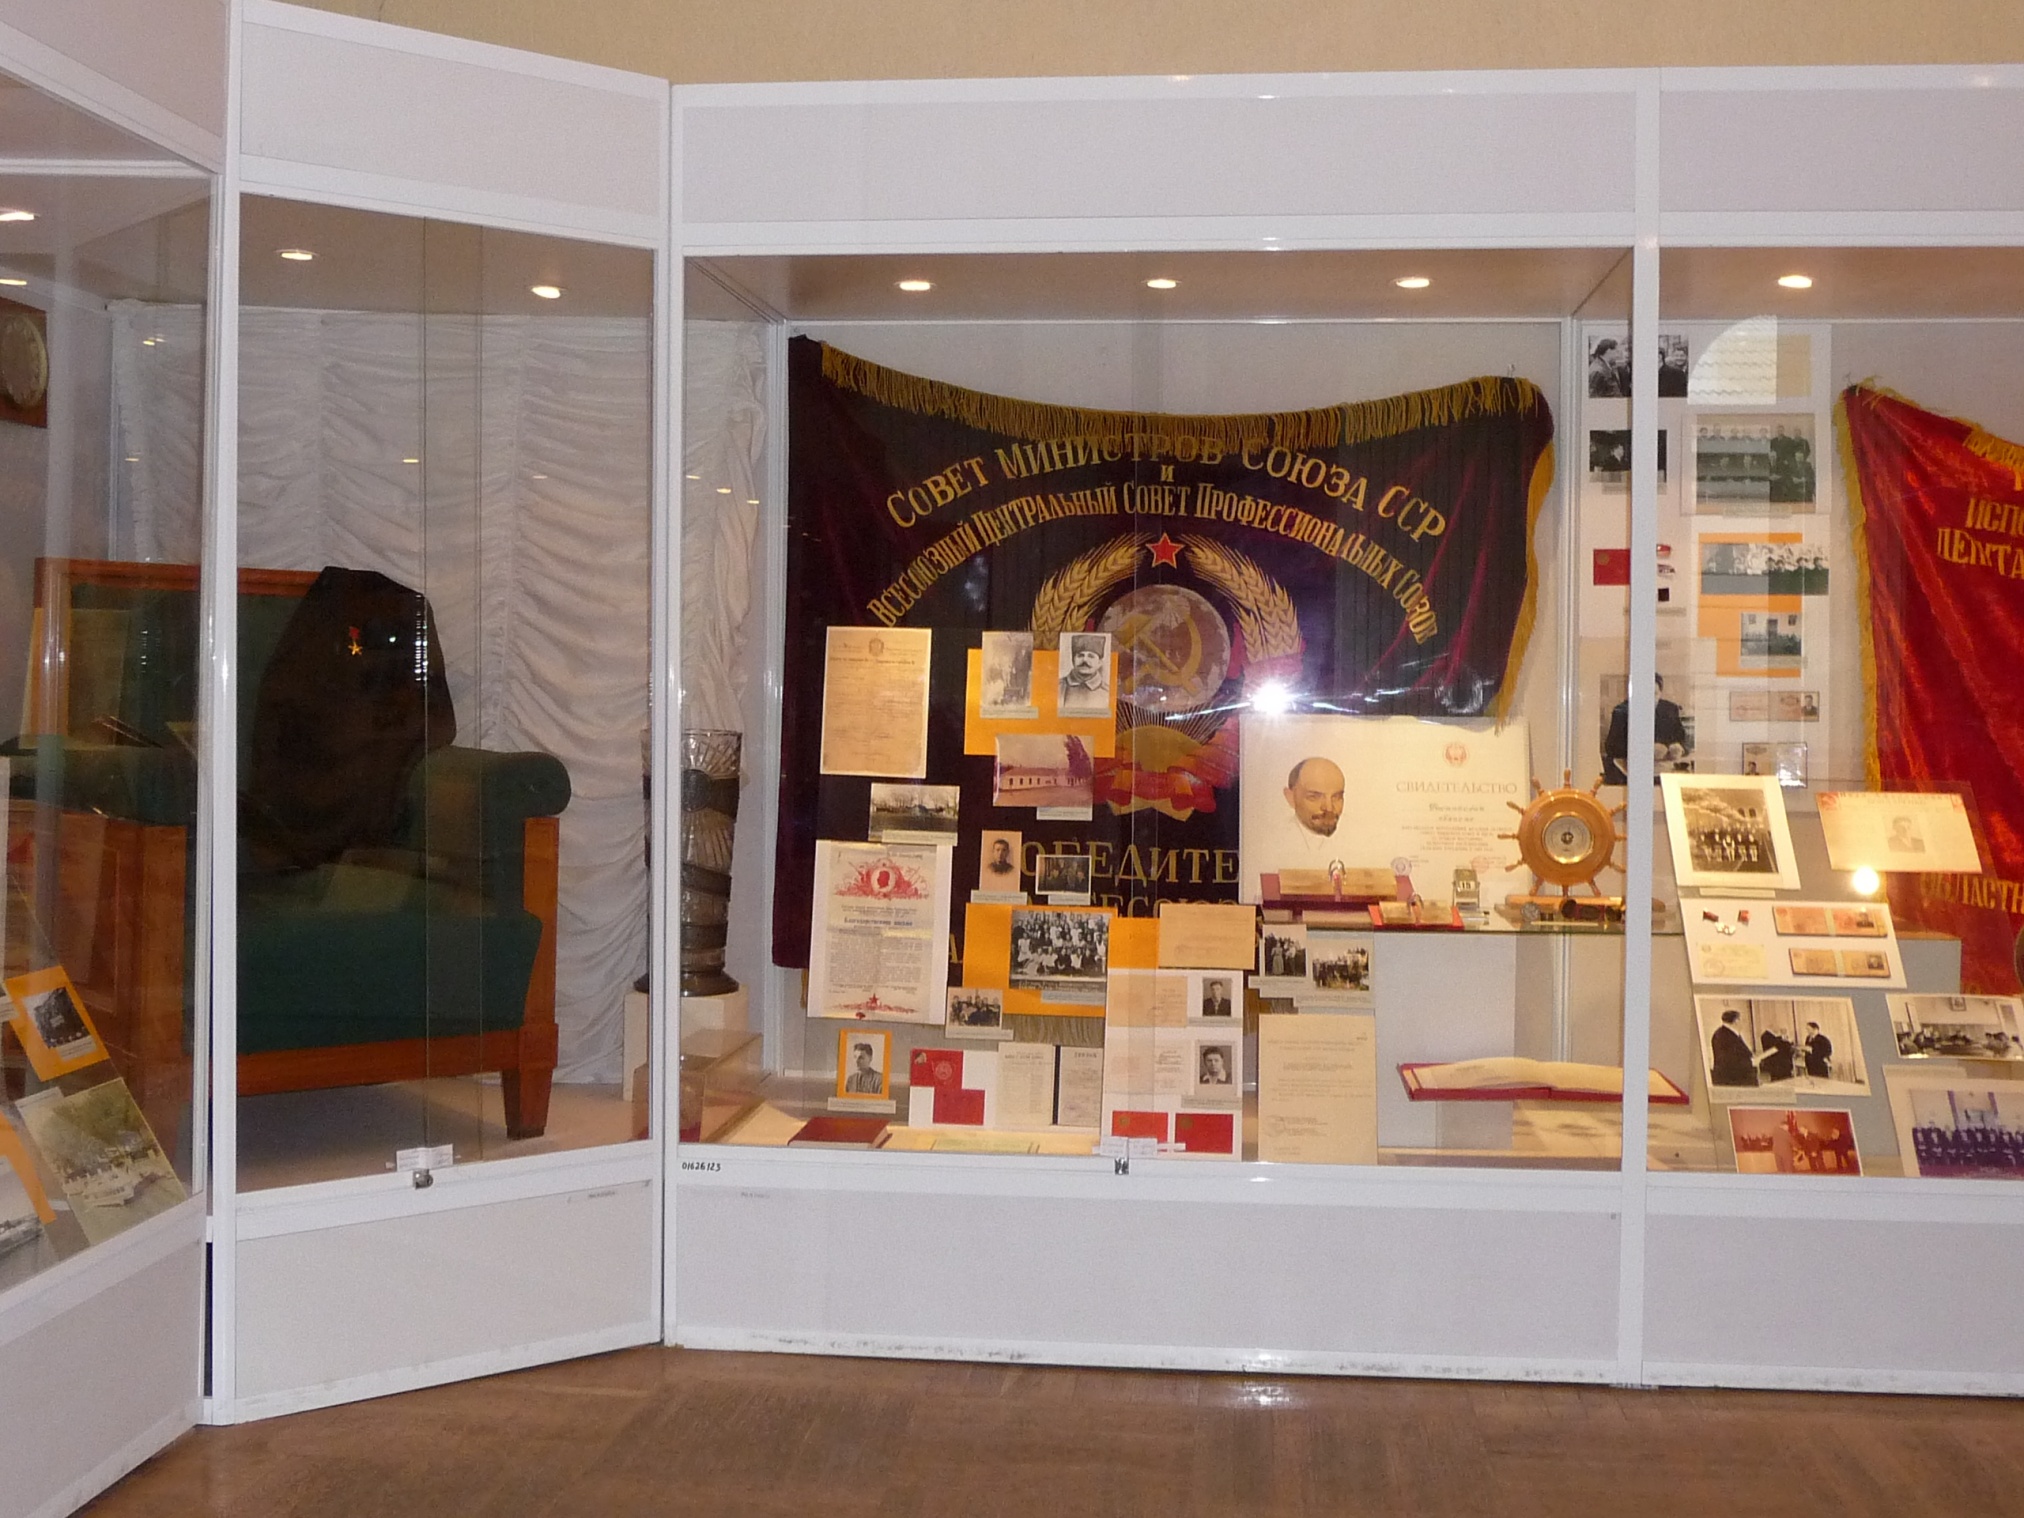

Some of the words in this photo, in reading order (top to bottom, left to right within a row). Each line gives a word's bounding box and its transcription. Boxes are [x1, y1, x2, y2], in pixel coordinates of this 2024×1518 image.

[886, 456, 990, 529] СОВЕТ
[1241, 438, 1368, 512] СОЮЗА
[1377, 485, 1447, 543] ССР
[970, 481, 1119, 547] ЦЕНТРАЛЬНЫЙ
[1123, 479, 1191, 516] СОВЕТ
